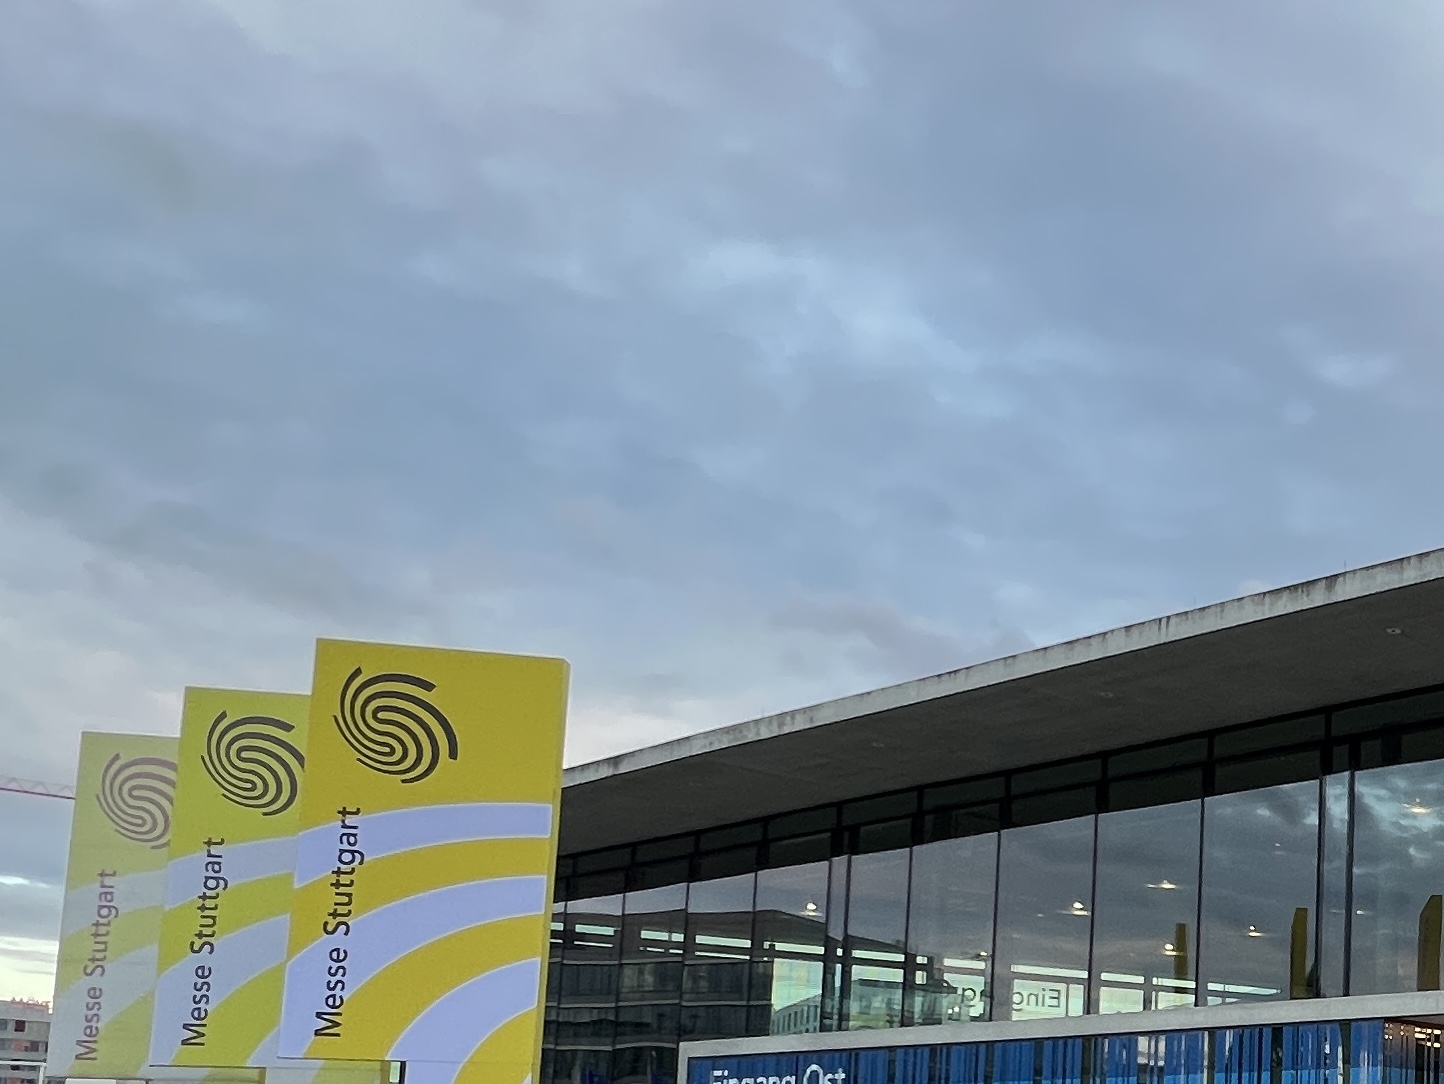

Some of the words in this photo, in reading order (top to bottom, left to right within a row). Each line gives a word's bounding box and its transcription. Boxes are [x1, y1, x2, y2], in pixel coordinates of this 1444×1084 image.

[189, 836, 227, 955] Stuttgart
[322, 805, 364, 936] Stuttgart
[84, 869, 118, 979] Stuttgart
[75, 985, 103, 1062] Messe
[181, 963, 213, 1048] Messe
[314, 948, 348, 1039] Messe
